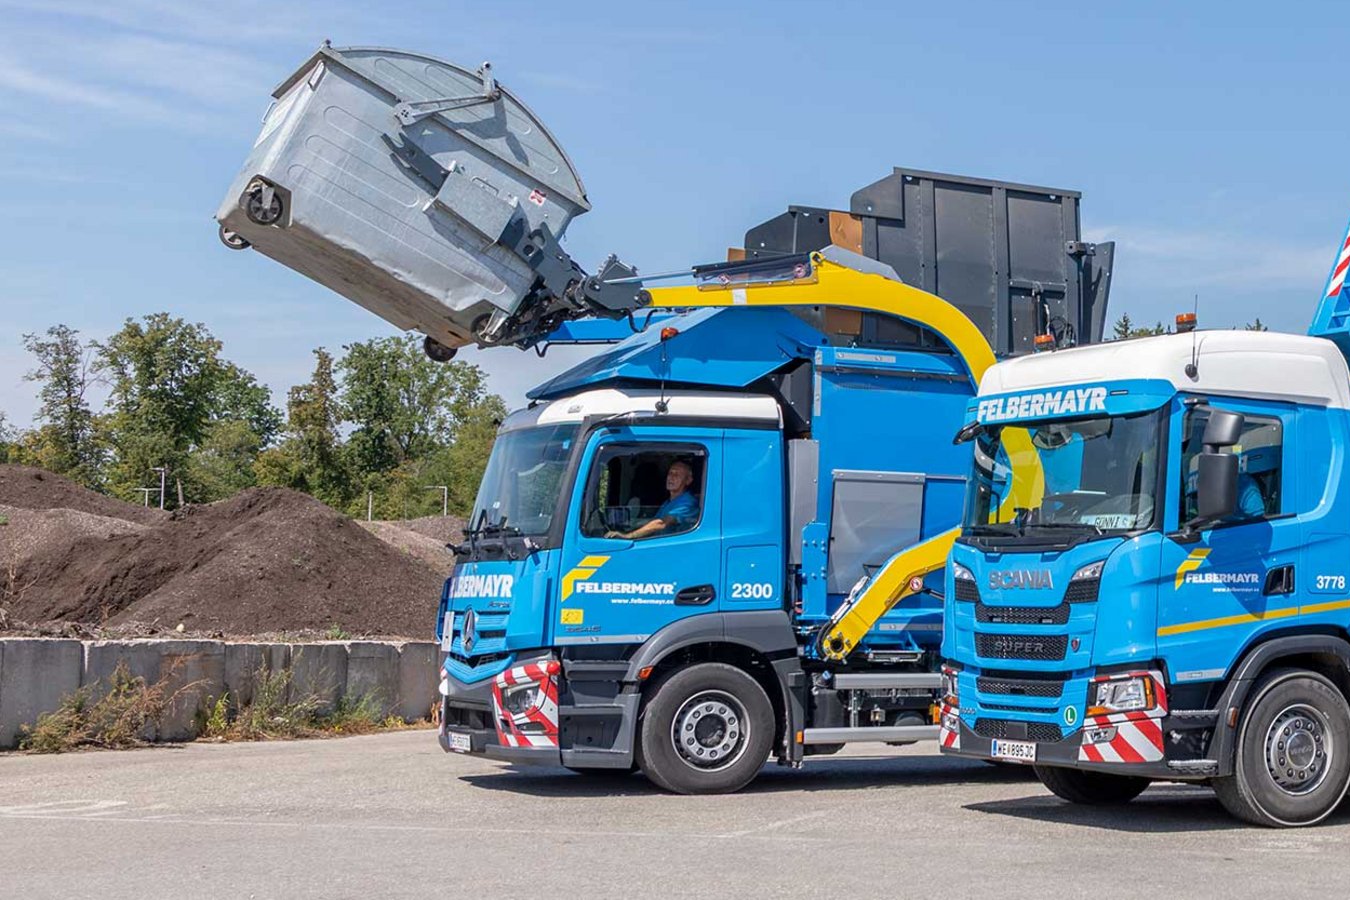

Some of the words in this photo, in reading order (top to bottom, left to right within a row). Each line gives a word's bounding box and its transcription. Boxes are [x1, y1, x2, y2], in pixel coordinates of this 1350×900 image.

[977, 387, 1107, 422] FELBERMAYR
[989, 569, 1054, 590] SCANIA
[1186, 573, 1260, 584] FELBERMAYR
[1316, 575, 1346, 589] 3778
[731, 583, 773, 598] 2300
[994, 641, 1044, 653] SUPER
